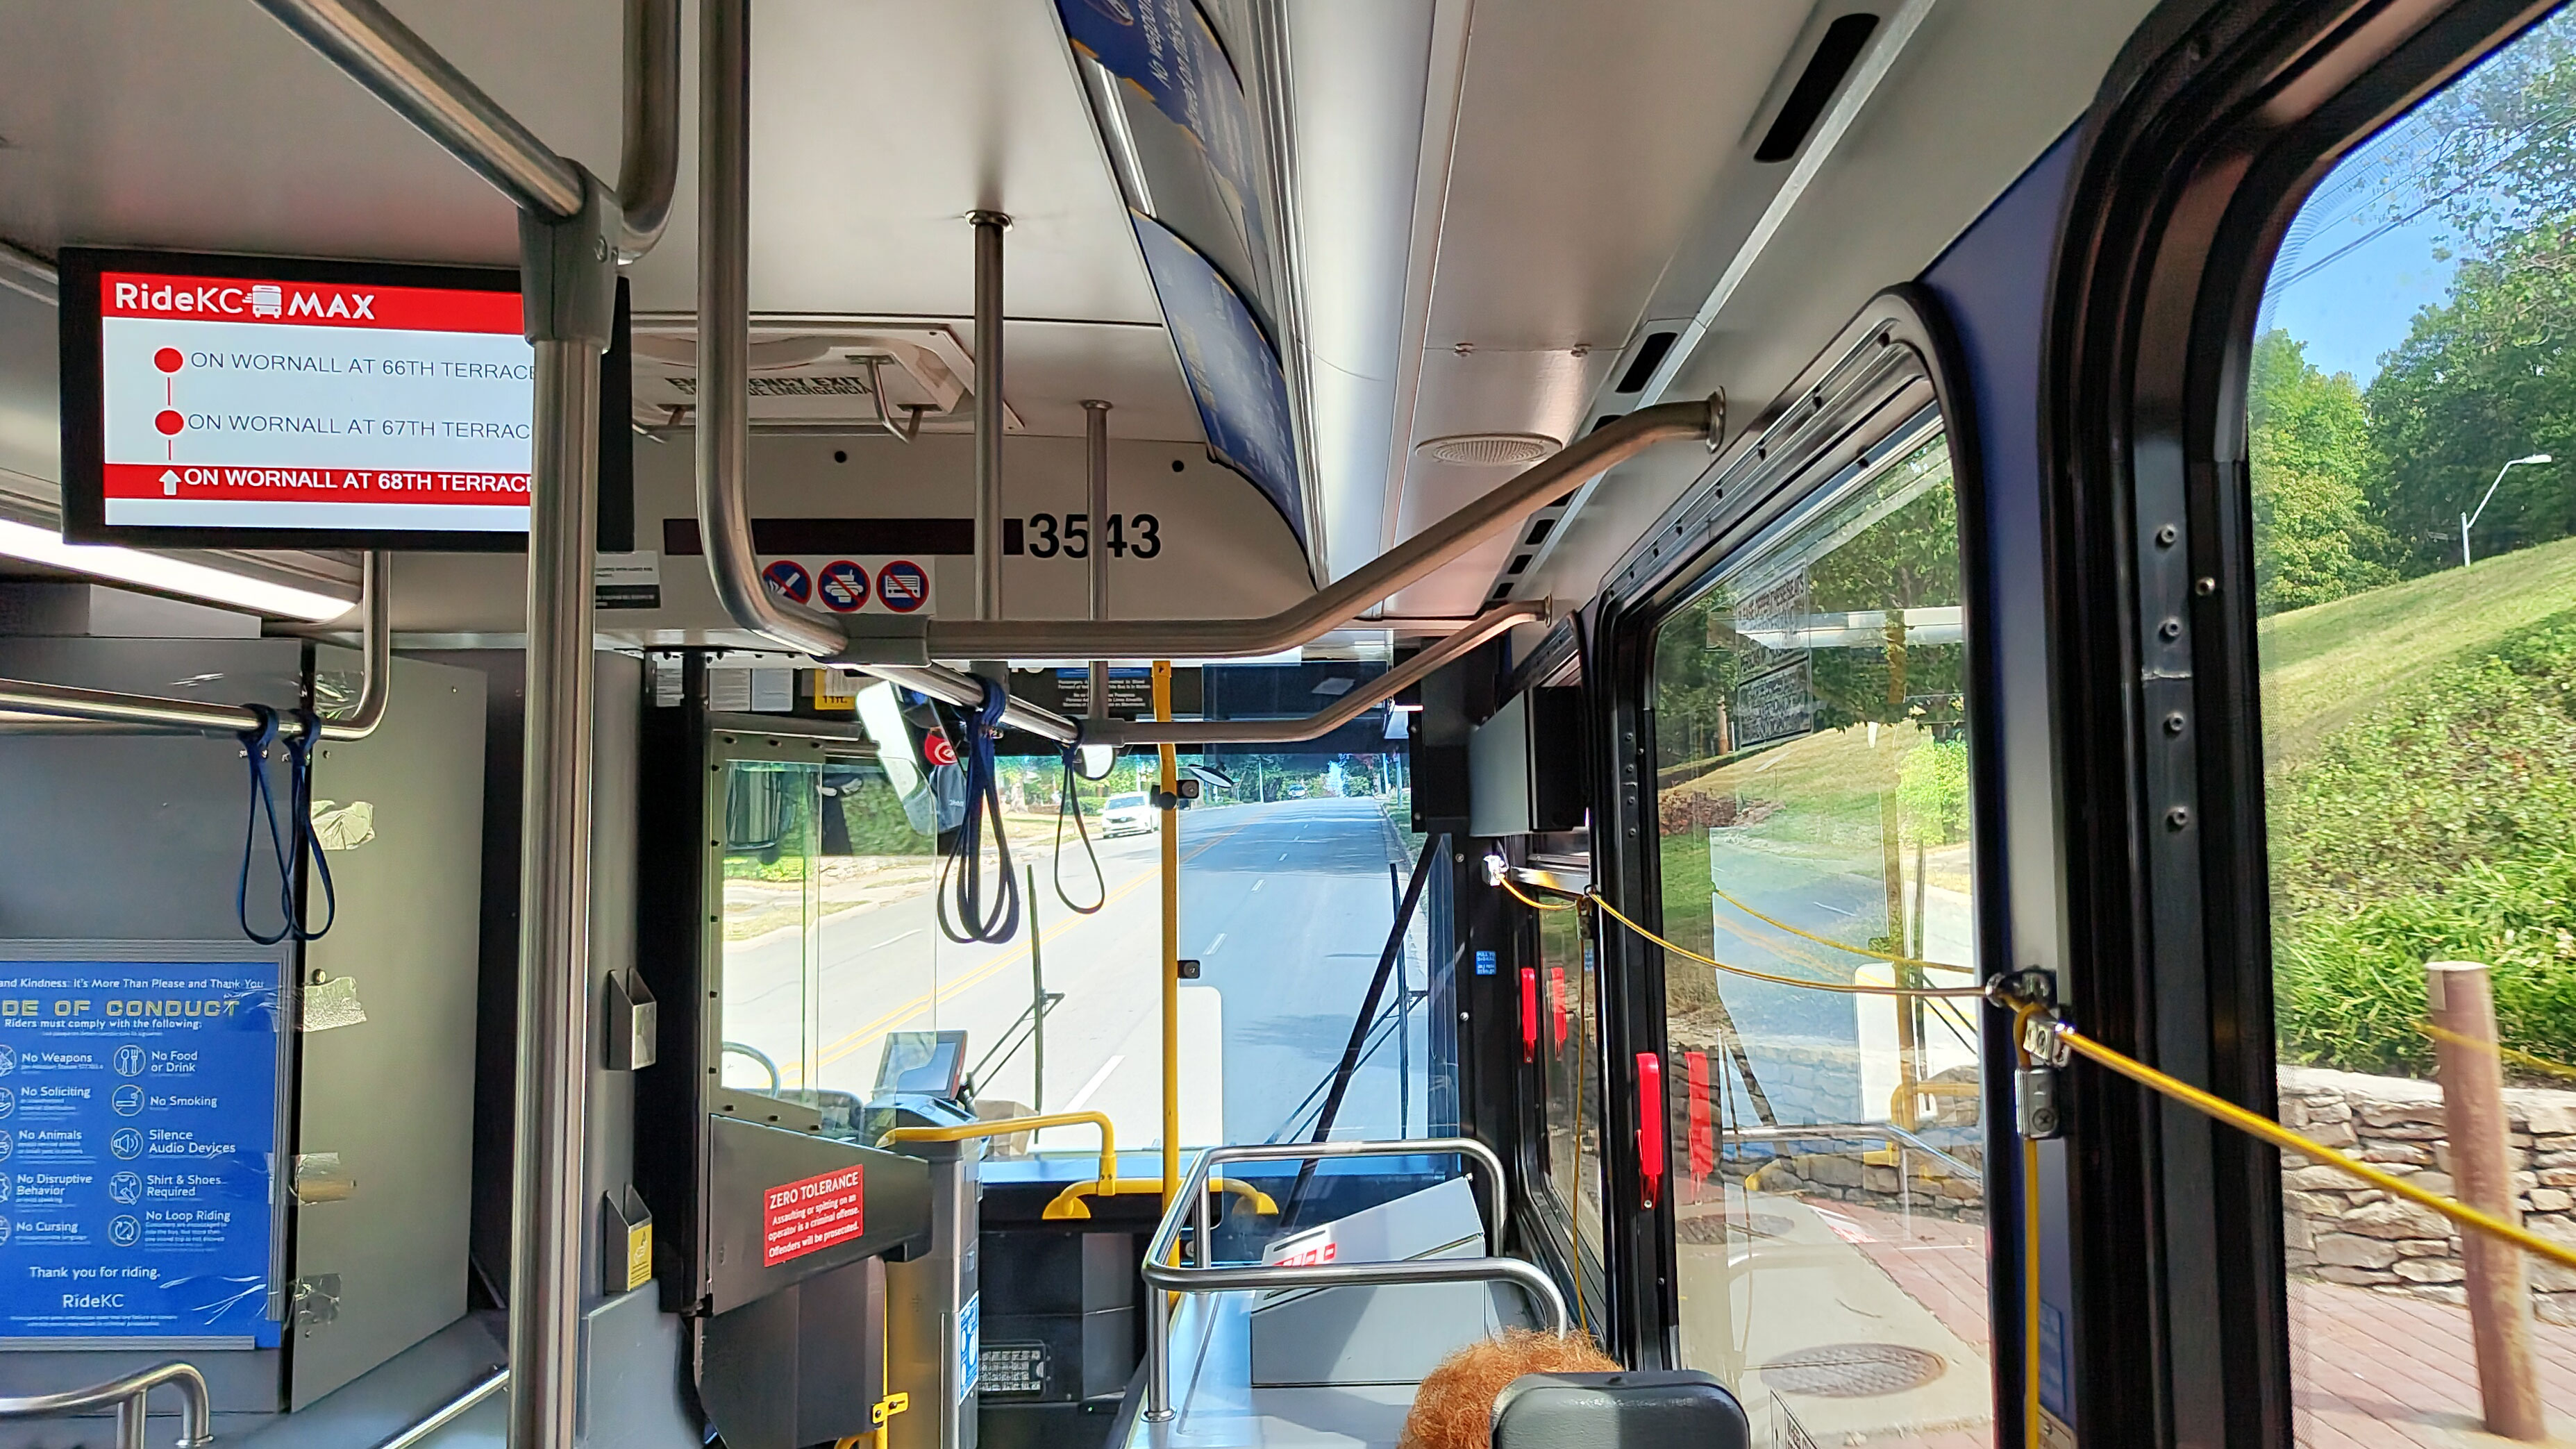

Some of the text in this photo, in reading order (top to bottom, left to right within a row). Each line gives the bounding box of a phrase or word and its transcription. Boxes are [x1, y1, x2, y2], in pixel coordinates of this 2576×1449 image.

[1138, 0, 1171, 90] No weapon
[115, 283, 375, 320] RideKC MAX
[191, 352, 224, 369] ON
[231, 353, 342, 373] WORNALL
[348, 358, 376, 374] AT
[383, 360, 434, 376] 66TH
[664, 377, 862, 387] EMENCY EXIT
[188, 414, 530, 439] ON WORNALL AT 67TH TERRAC
[184, 468, 219, 485] ON
[225, 469, 338, 488] WORNALL
[343, 472, 372, 489] AT
[378, 473, 432, 490] 68TH
[1029, 513, 1161, 559] 3543
[74, 978, 88, 987] It's
[92, 979, 120, 988] More
[124, 979, 148, 988] Than
[152, 979, 185, 989] Please
[188, 979, 207, 988] and
[210, 979, 240, 989] Thank
[244, 979, 264, 989] You
[2, 1000, 240, 1016] DE OF CONDUCT
[5, 1019, 37, 1028] Riders
[40, 1019, 65, 1028] must
[68, 1019, 106, 1030] comply
[109, 1019, 130, 1028] with
[133, 1019, 149, 1028] the
[22, 1053, 92, 1064] No Weapons
[151, 1050, 198, 1060] No Food
[166, 1062, 196, 1072] Drink
[21, 1086, 91, 1098] No Soliciting
[150, 1096, 217, 1108] No Smoking
[19, 1130, 82, 1140] No Animals
[149, 1129, 193, 1140] Silence
[149, 1142, 236, 1153] Audio Devices
[17, 1173, 93, 1186] No Disruptive
[147, 1175, 221, 1184] Shirt & Shoes
[17, 1185, 65, 1196] Behavior
[147, 1187, 196, 1198] Required
[769, 1171, 859, 1209] ZERO TOLERANCE
[146, 1210, 231, 1222] No Loop Riding
[772, 1208, 806, 1226] Assaulting
[807, 1207, 814, 1215] or
[815, 1198, 839, 1214] spitting
[839, 1196, 848, 1205] on
[16, 1221, 78, 1233] No Cursing
[768, 1225, 797, 1241] operator
[797, 1222, 804, 1232] is
[805, 1221, 810, 1230] a
[810, 1212, 836, 1228] criminal
[769, 1221, 859, 1257] Offenders will be prosecuted.
[28, 1266, 160, 1280] Thank you for riding.
[62, 1293, 124, 1308] RideKC
